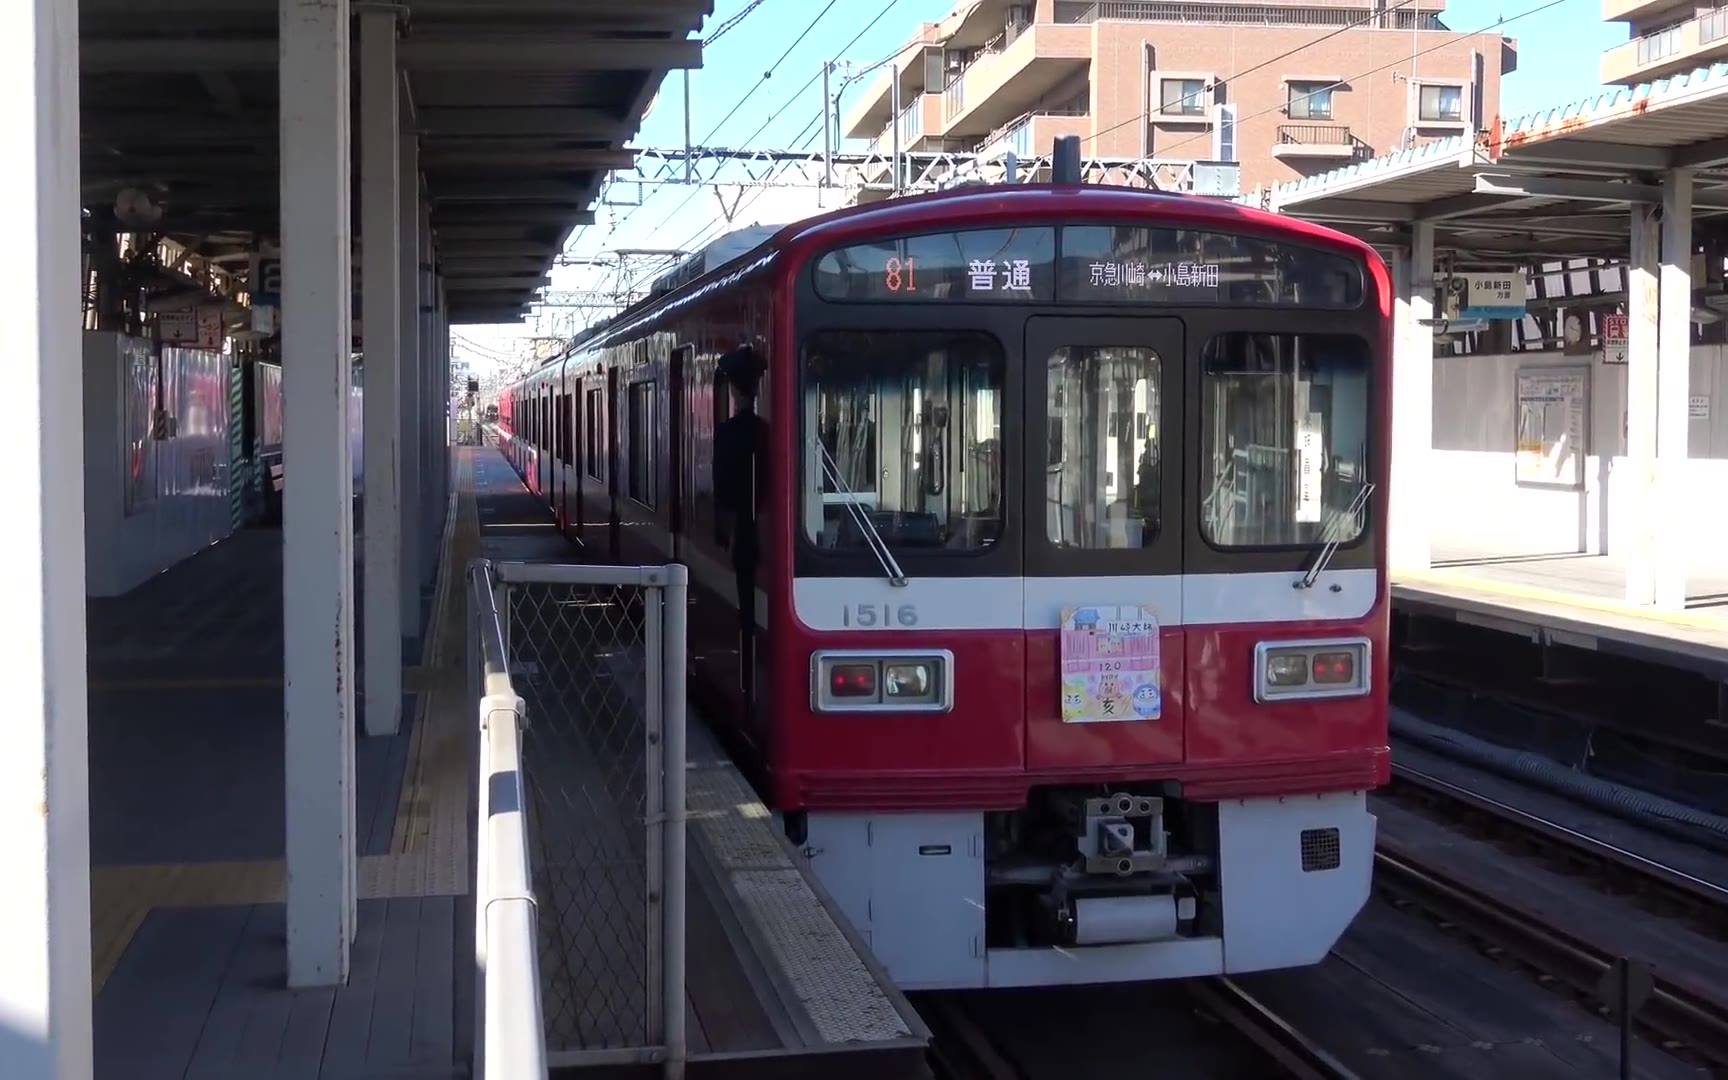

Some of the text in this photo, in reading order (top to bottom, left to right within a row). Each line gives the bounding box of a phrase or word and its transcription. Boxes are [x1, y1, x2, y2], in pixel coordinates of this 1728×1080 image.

[886, 257, 916, 291] 81
[968, 259, 1031, 291] 普通
[1163, 263, 1219, 287] 小島新田
[1474, 280, 1511, 290] 小島新田
[843, 603, 918, 627] 1516
[1099, 661, 1121, 671] 120
